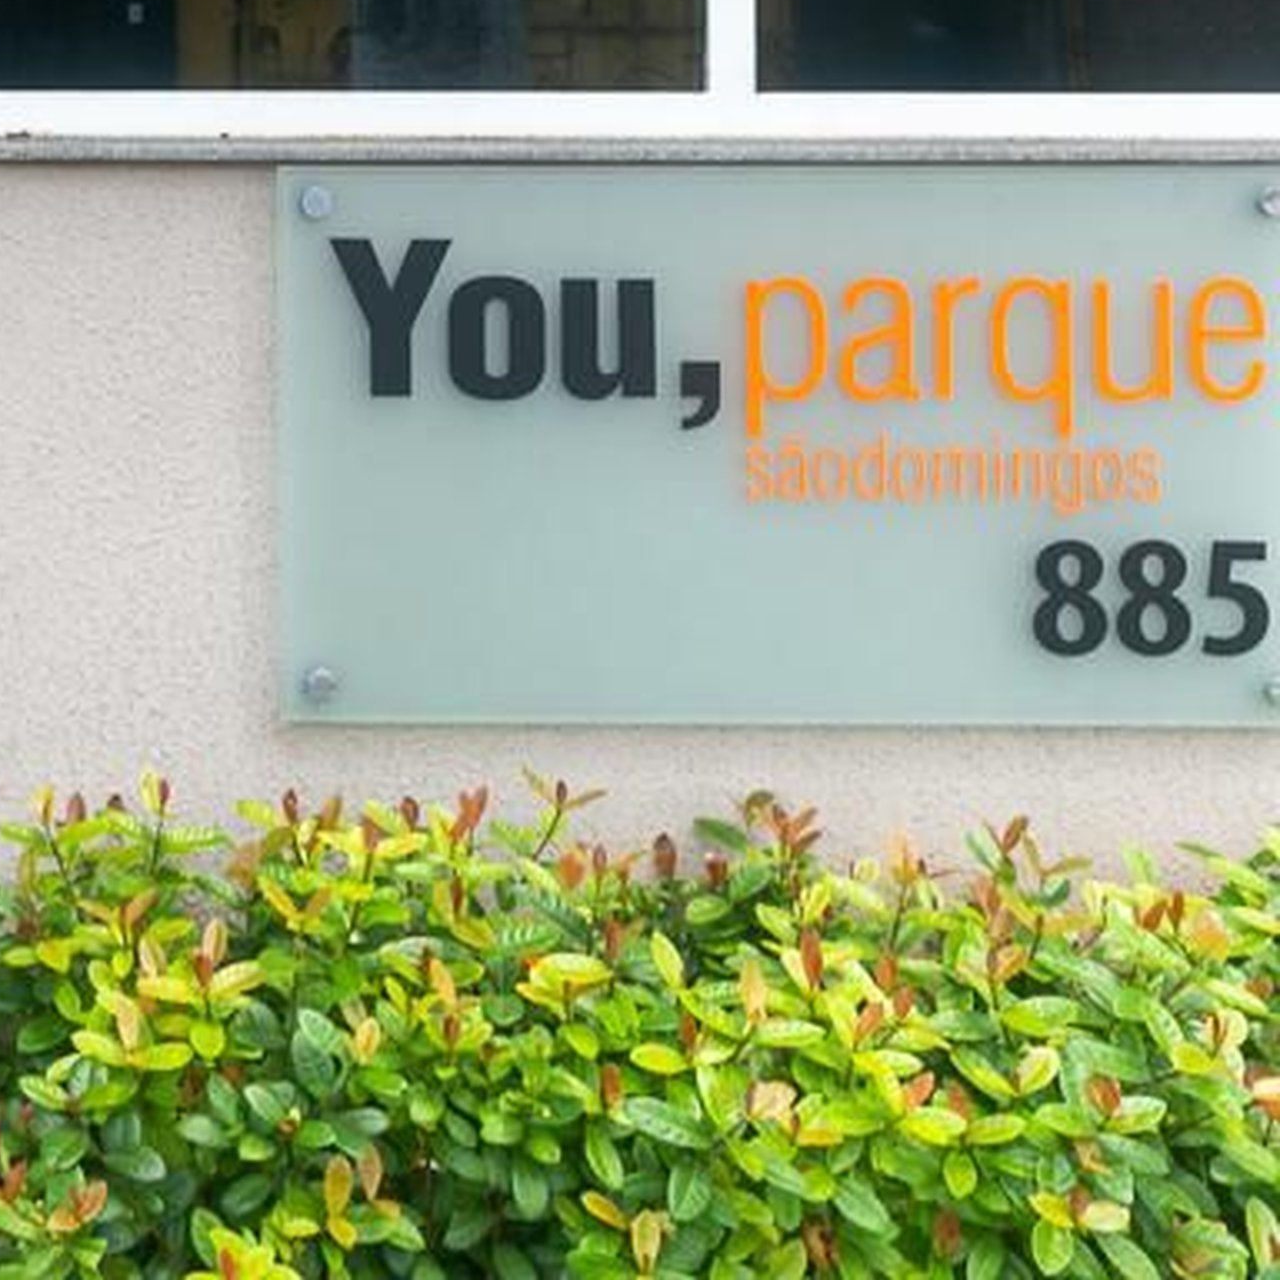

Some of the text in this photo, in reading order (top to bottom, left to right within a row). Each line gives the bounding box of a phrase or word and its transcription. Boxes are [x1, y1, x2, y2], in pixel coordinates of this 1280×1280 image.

[330, 237, 1268, 437] You, parque
[744, 428, 1164, 516] sãodomingos
[1031, 539, 1271, 658] 885
